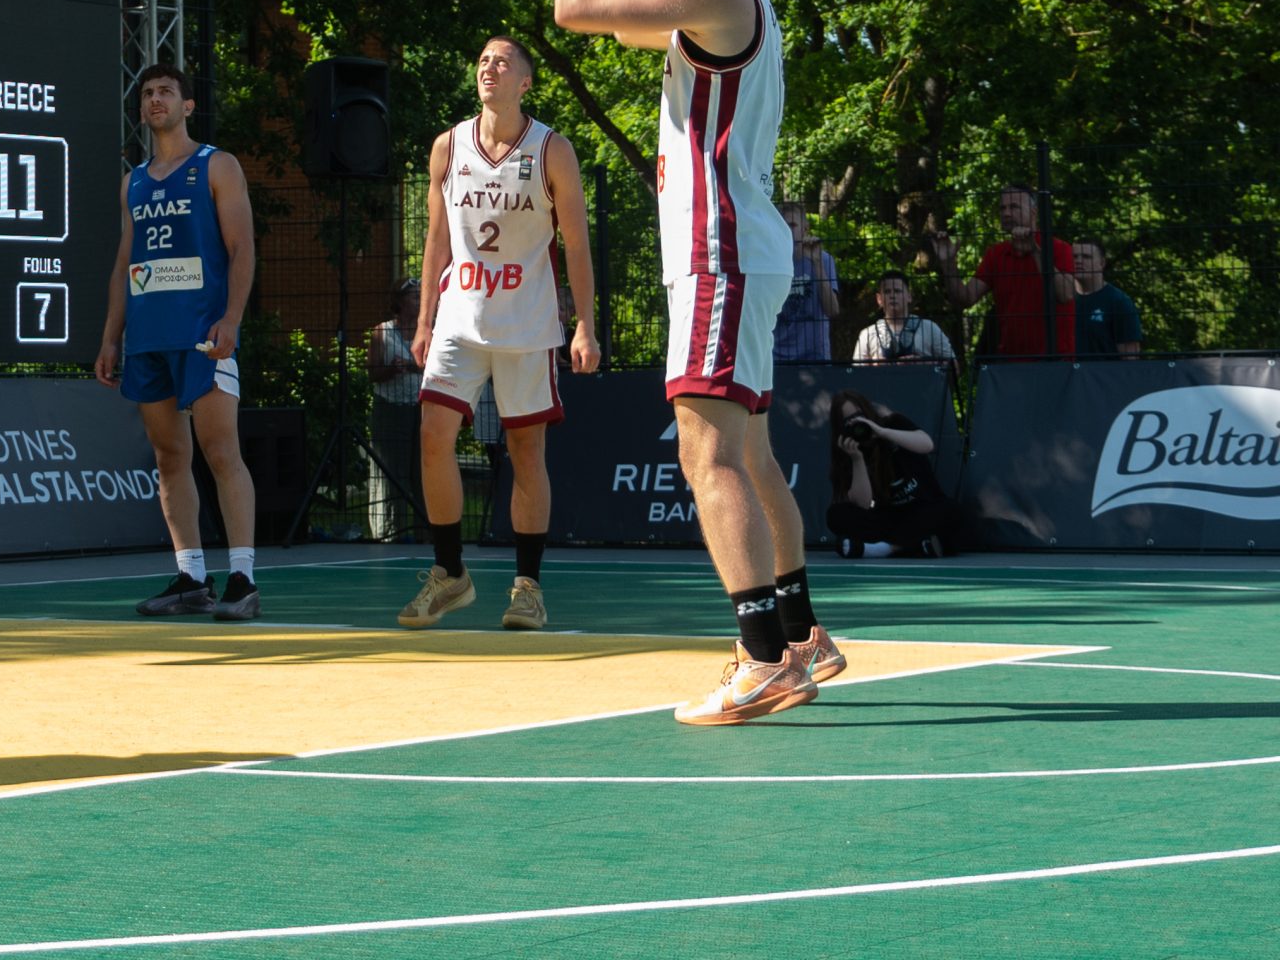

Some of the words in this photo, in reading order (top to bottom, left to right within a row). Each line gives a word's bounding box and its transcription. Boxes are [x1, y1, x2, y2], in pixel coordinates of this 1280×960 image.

[132, 199, 192, 221] ΕΛΛΑΣ
[454, 191, 534, 211] ATVIJA
[146, 225, 173, 250] 22
[477, 221, 500, 252] 2
[24, 257, 62, 275] FOULS
[154, 266, 186, 274] ΟΜΑΔΑ
[34, 293, 52, 331] 7
